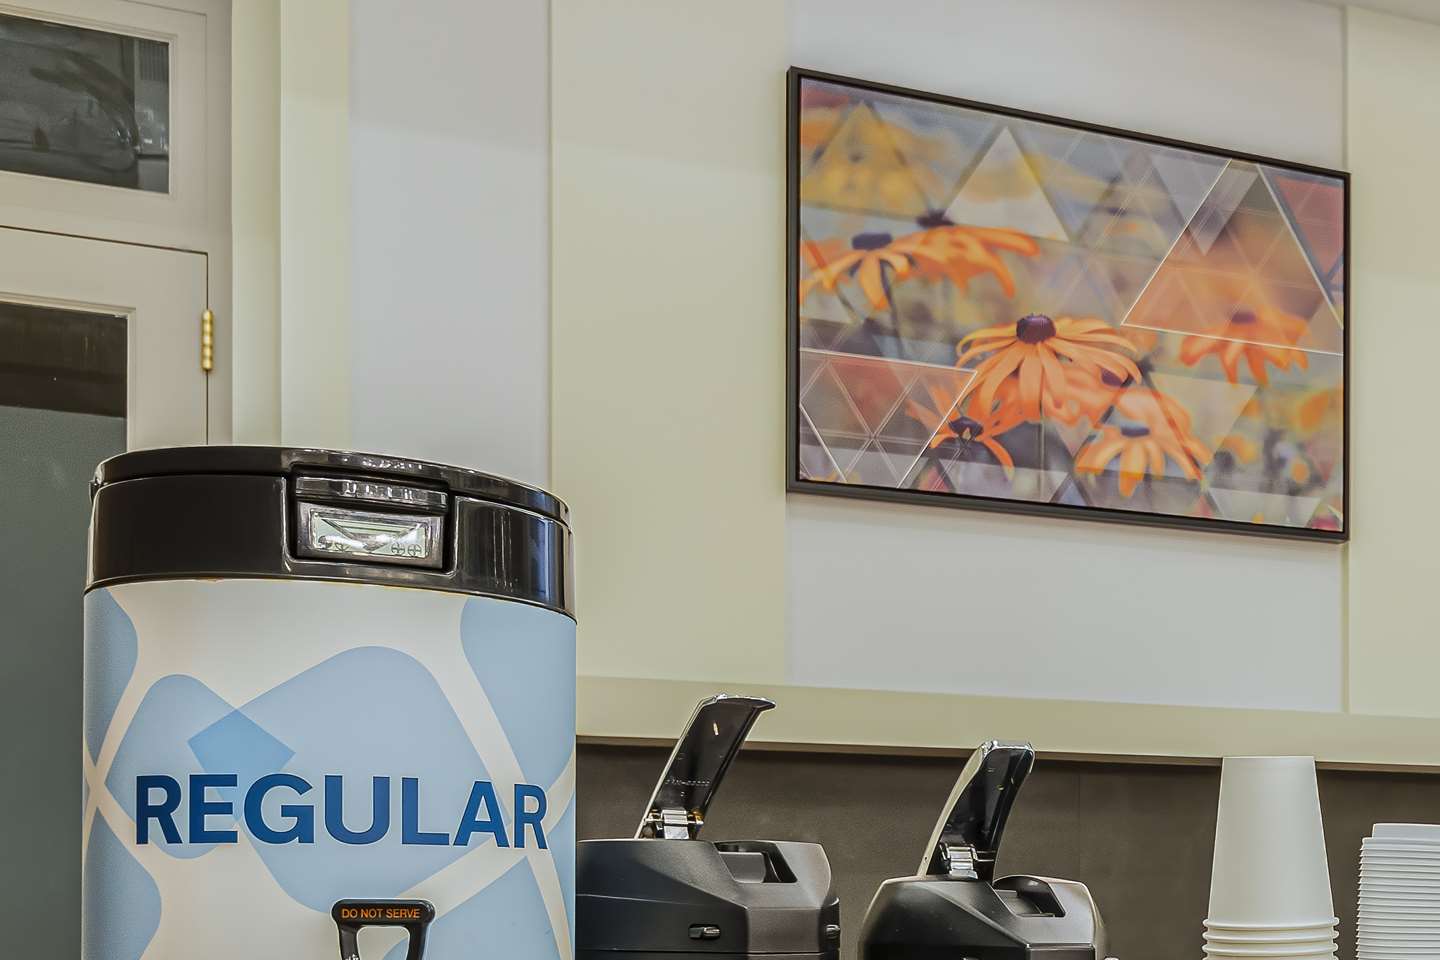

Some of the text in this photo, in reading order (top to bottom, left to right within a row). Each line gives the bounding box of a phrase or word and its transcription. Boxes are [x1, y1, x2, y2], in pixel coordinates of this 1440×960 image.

[136, 773, 549, 850] REGULAR
[341, 908, 421, 919] DO NOT SERVE
